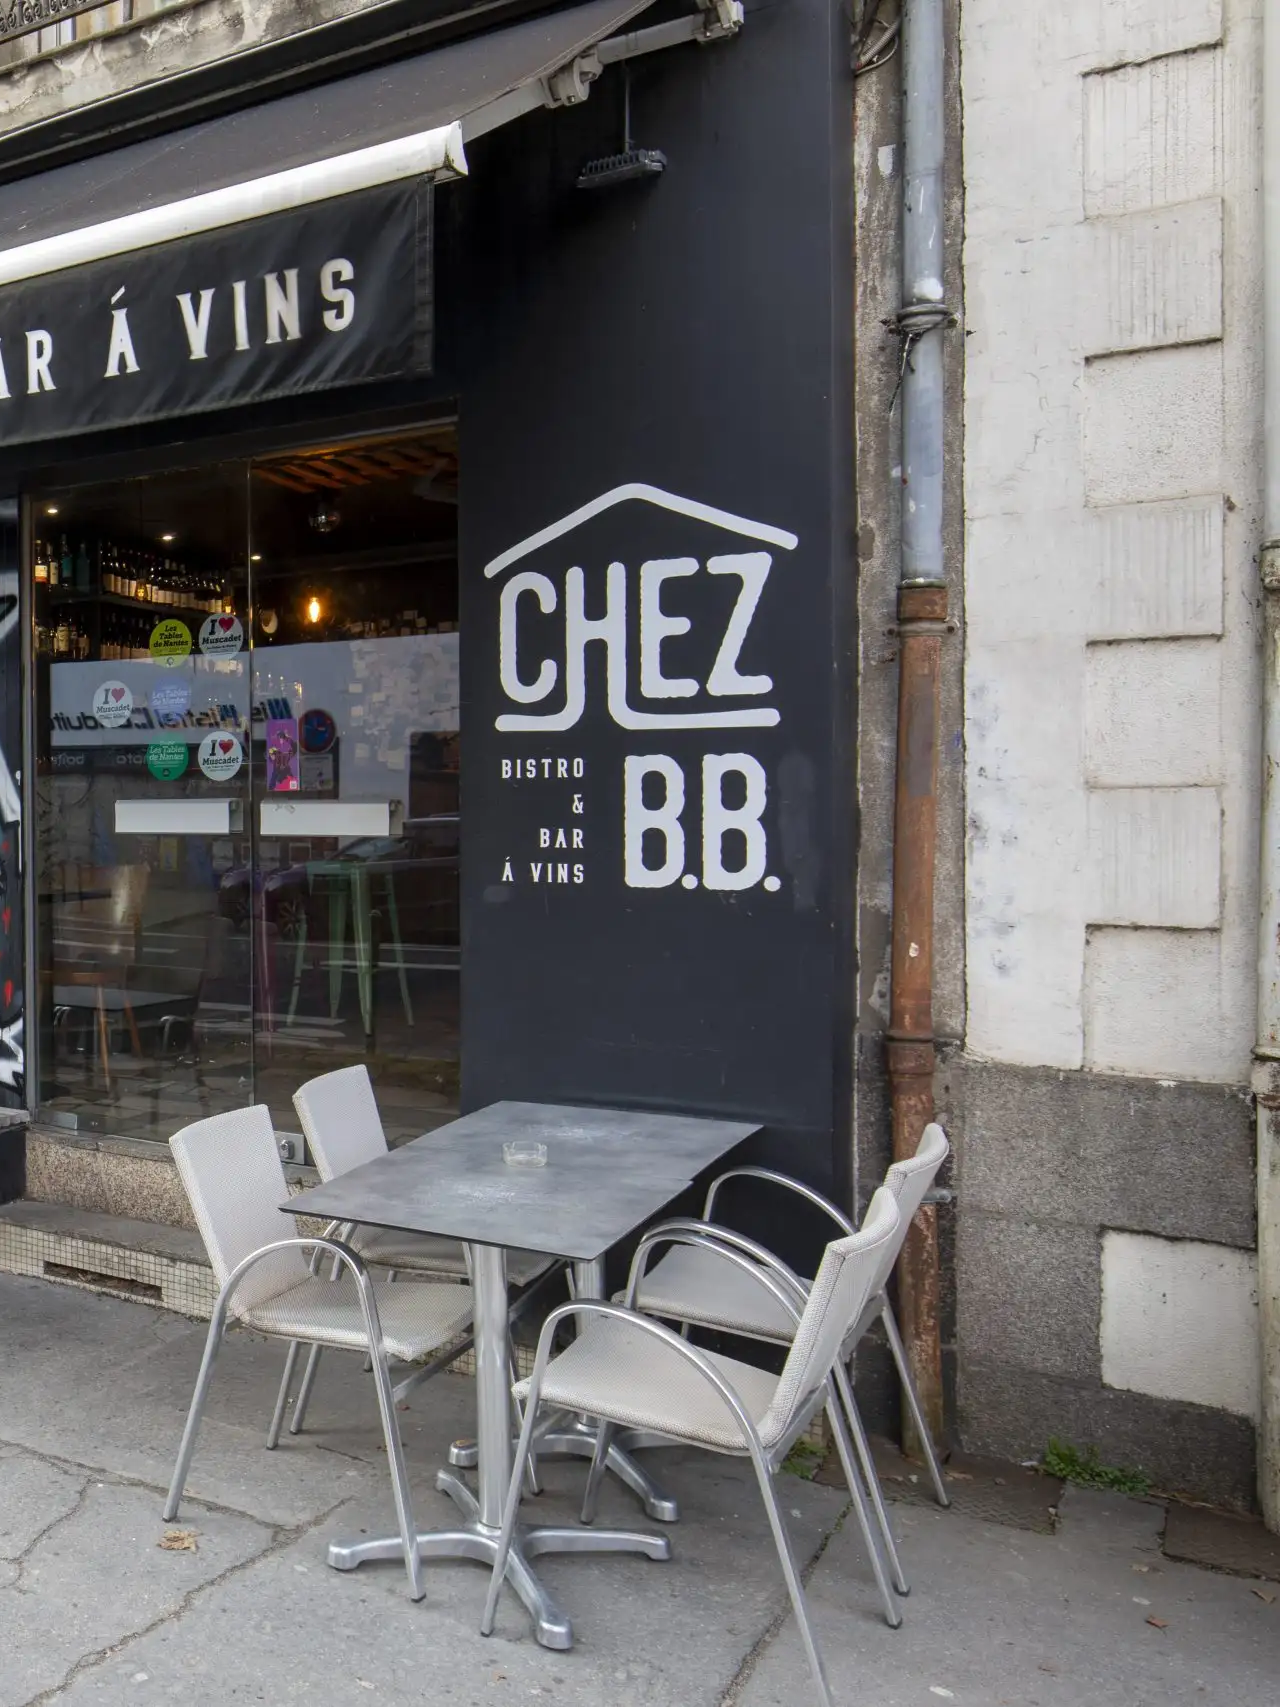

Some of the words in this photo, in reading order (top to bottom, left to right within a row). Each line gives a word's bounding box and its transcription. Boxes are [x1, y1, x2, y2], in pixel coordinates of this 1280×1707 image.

[176, 257, 355, 360] VINS
[159, 632, 183, 640] Tables
[208, 619, 218, 636] I
[163, 640, 189, 648] Nantes
[201, 633, 242, 645] Muscadet
[496, 551, 778, 731] CHEZ
[102, 688, 111, 705] I
[96, 704, 130, 714] Muscadet
[162, 745, 185, 753] Tables
[209, 739, 218, 756] I
[159, 753, 185, 761] Nantes
[202, 755, 240, 766] Muscadet
[501, 758, 585, 779] BISTRO
[572, 794, 584, 814] &
[624, 753, 781, 891] B.B.
[539, 828, 584, 849] BAR
[530, 862, 584, 884] VINS
